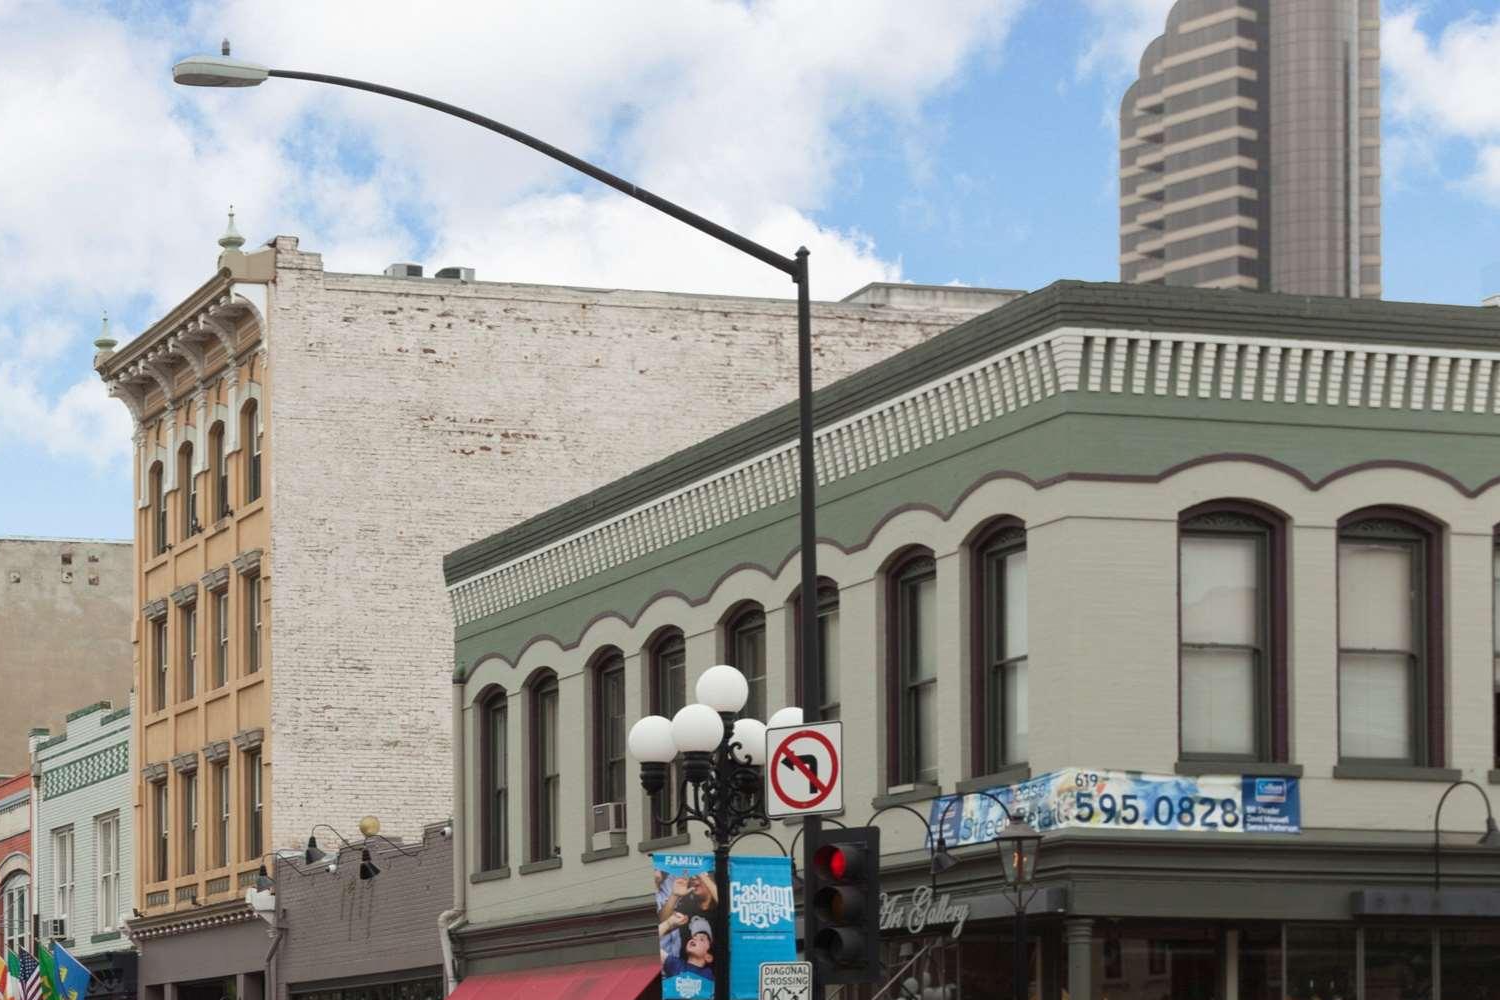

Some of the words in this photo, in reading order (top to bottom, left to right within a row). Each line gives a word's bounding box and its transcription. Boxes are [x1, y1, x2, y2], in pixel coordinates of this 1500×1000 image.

[1075, 774, 1098, 788] 619
[1075, 792, 1239, 828] 595.0828
[961, 816, 1008, 840] Stree
[665, 855, 703, 866] FAMILY
[907, 885, 969, 938] Gallery
[764, 966, 809, 975] DIAGONAL
[764, 977, 809, 986] CROSSING
